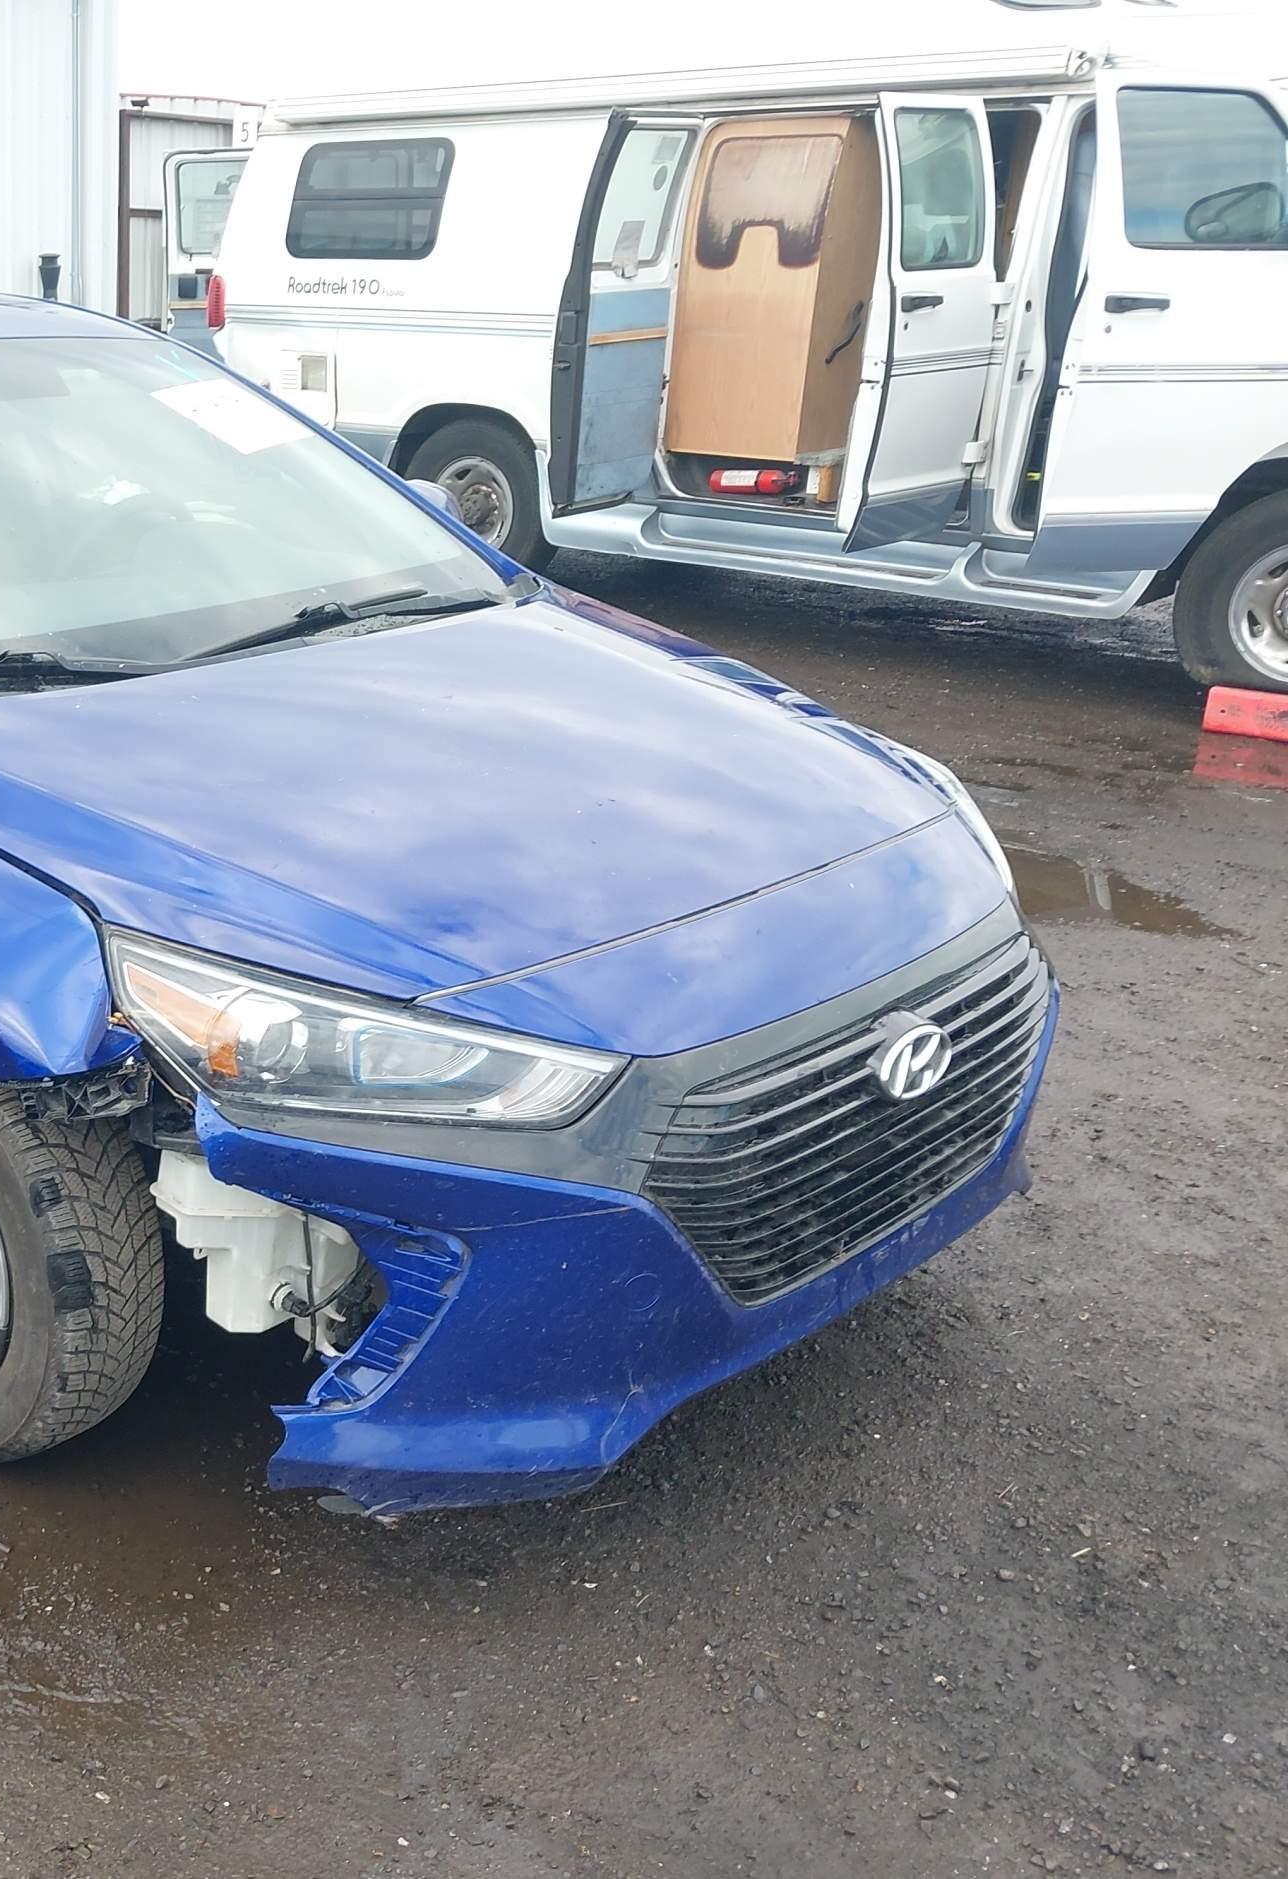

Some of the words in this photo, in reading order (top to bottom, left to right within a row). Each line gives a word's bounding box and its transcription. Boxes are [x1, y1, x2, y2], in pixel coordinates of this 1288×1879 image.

[241, 121, 249, 143] 5
[288, 276, 347, 295] Roadtrek
[352, 279, 380, 295] 190
